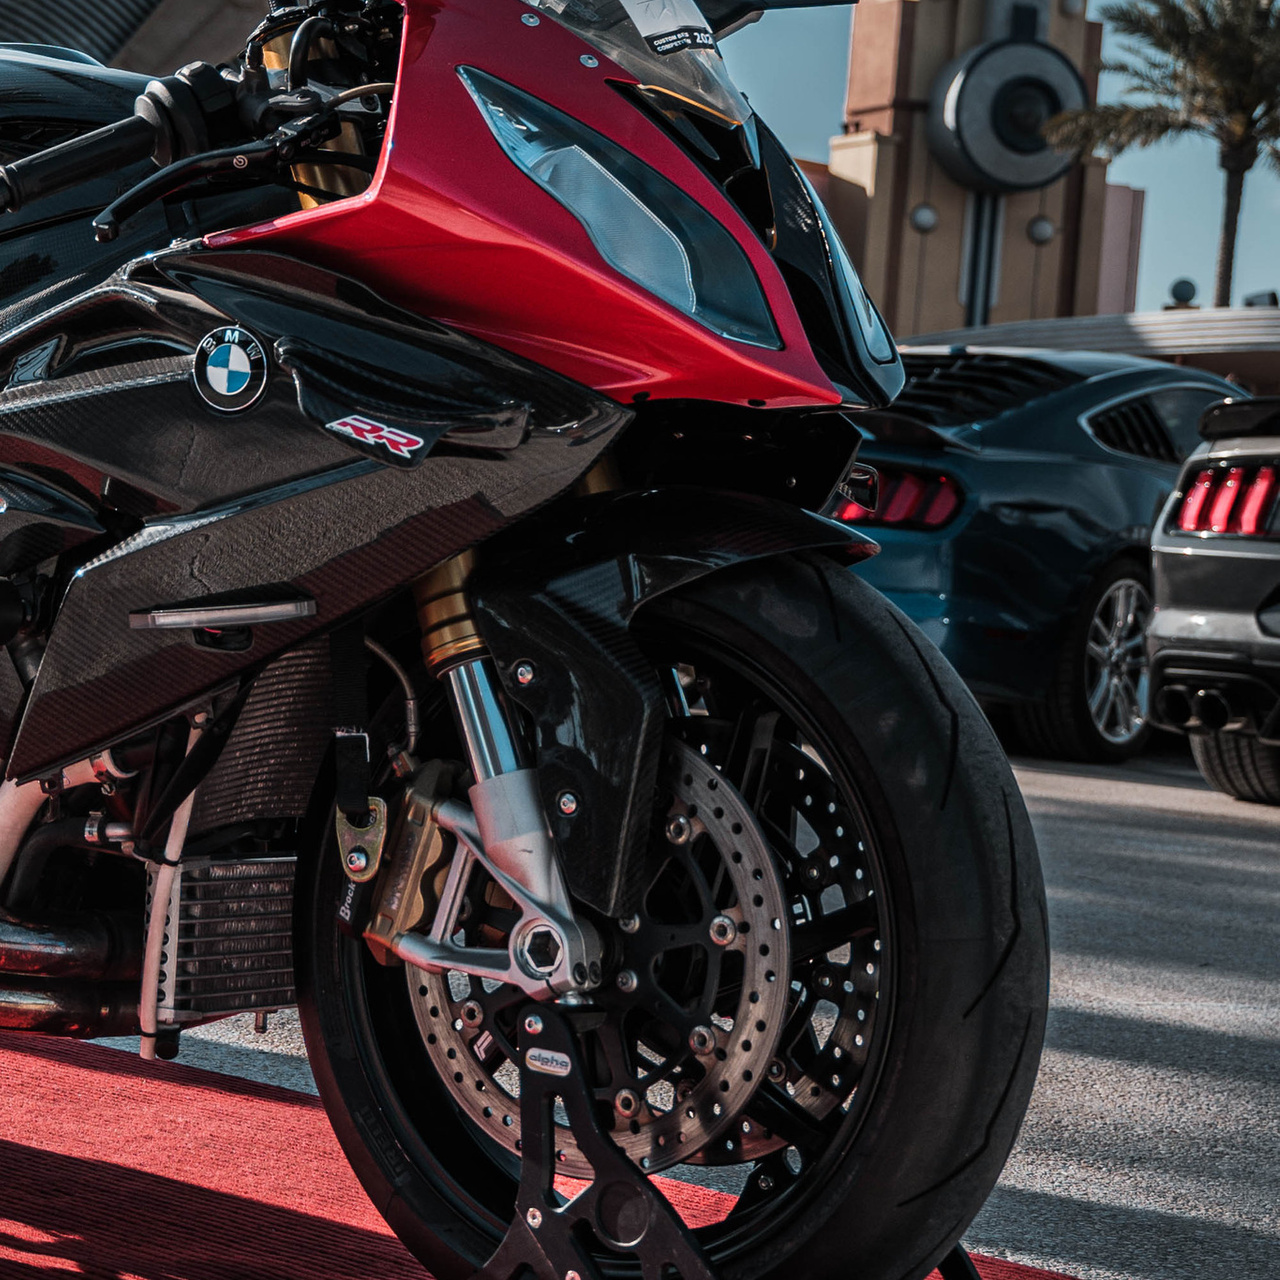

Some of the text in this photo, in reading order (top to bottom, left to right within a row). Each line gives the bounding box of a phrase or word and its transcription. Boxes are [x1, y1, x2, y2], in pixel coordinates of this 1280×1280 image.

[202, 329, 262, 360] BMW
[331, 416, 423, 456] RR
[528, 1053, 569, 1068] alpha
